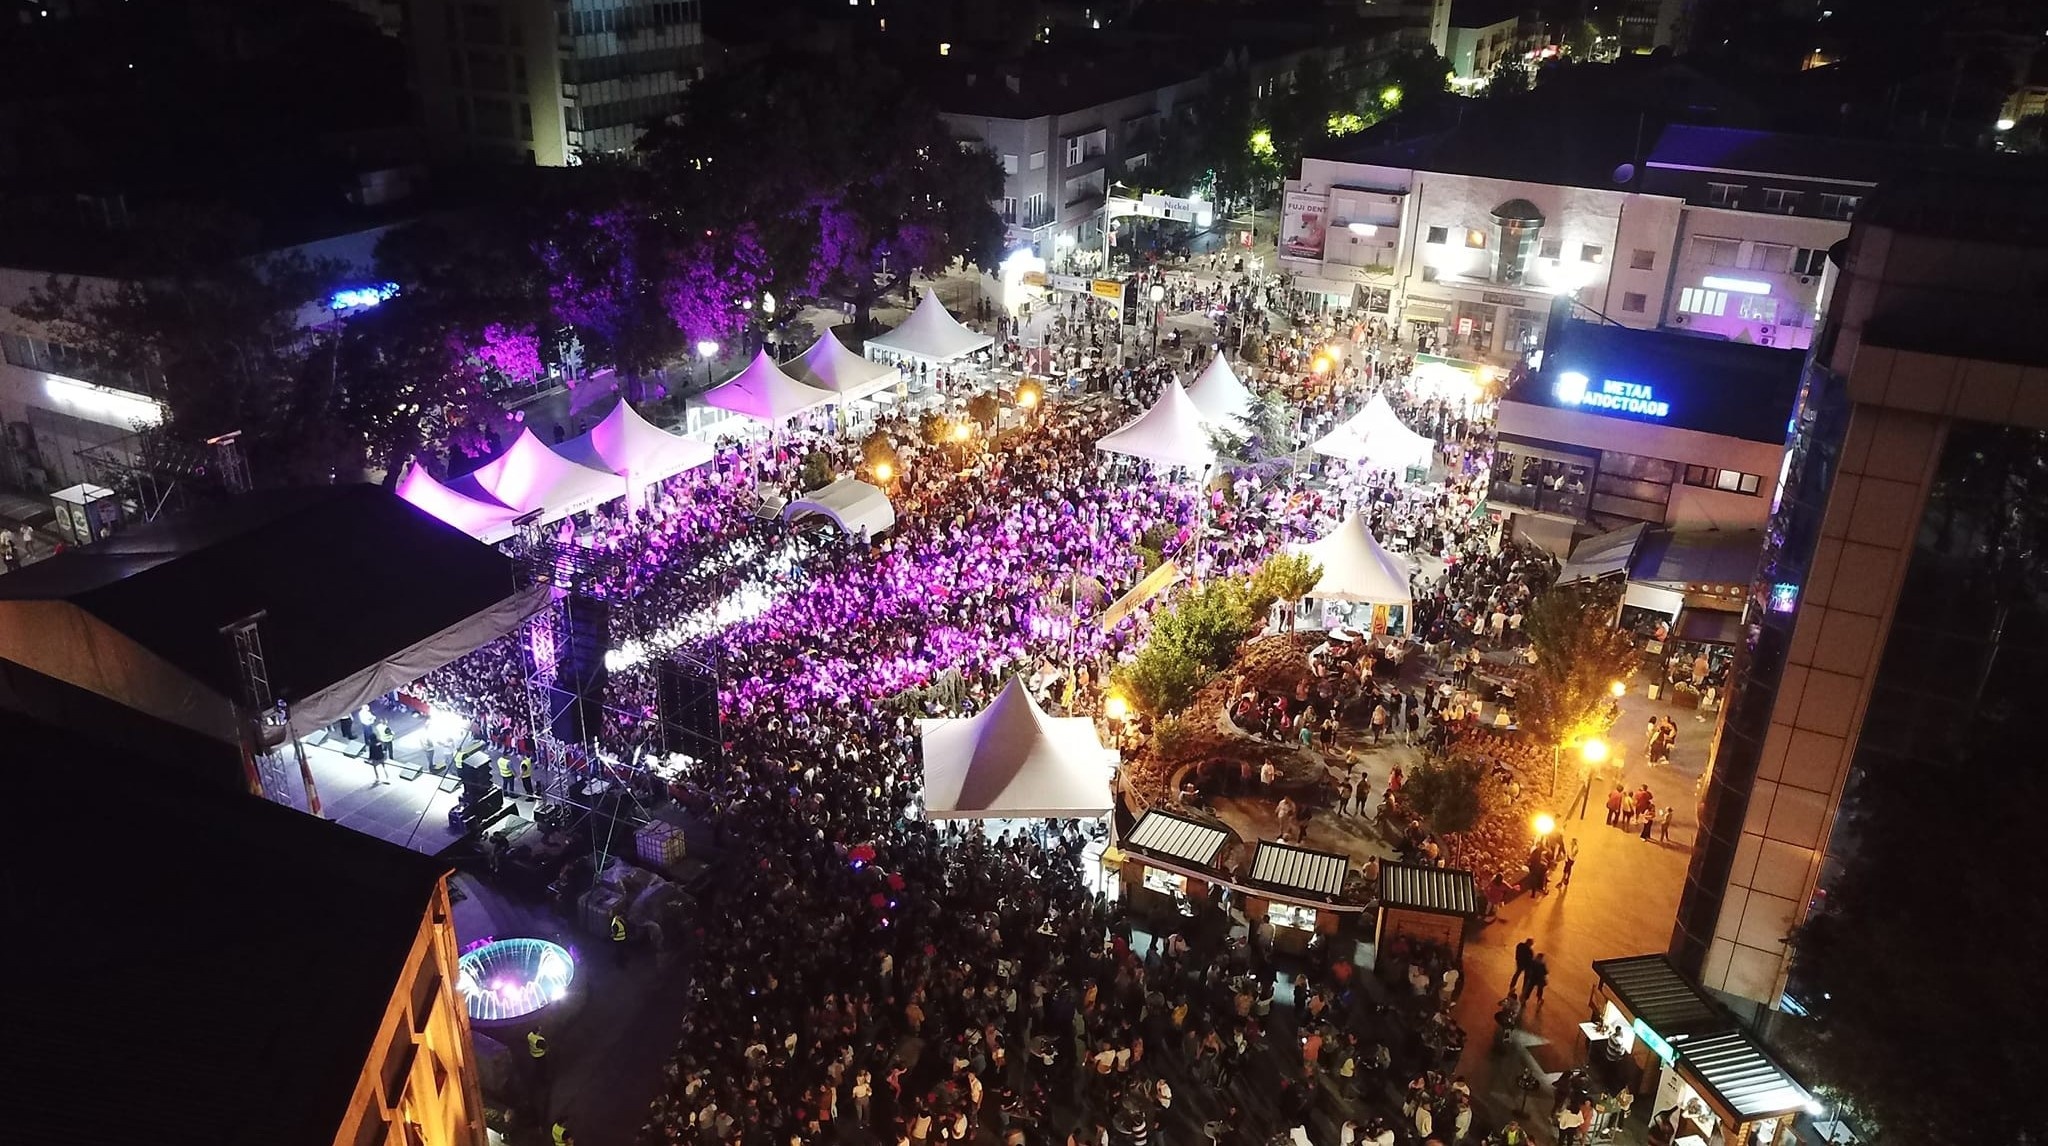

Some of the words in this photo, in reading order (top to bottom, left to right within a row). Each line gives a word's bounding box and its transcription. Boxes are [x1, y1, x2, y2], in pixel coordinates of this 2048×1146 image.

[1288, 203, 1305, 211] FUJI
[1307, 205, 1328, 213] DENT
[1603, 379, 1652, 400] МЕТАЛ
[1582, 391, 1669, 417] АПОСТОЛОВ
